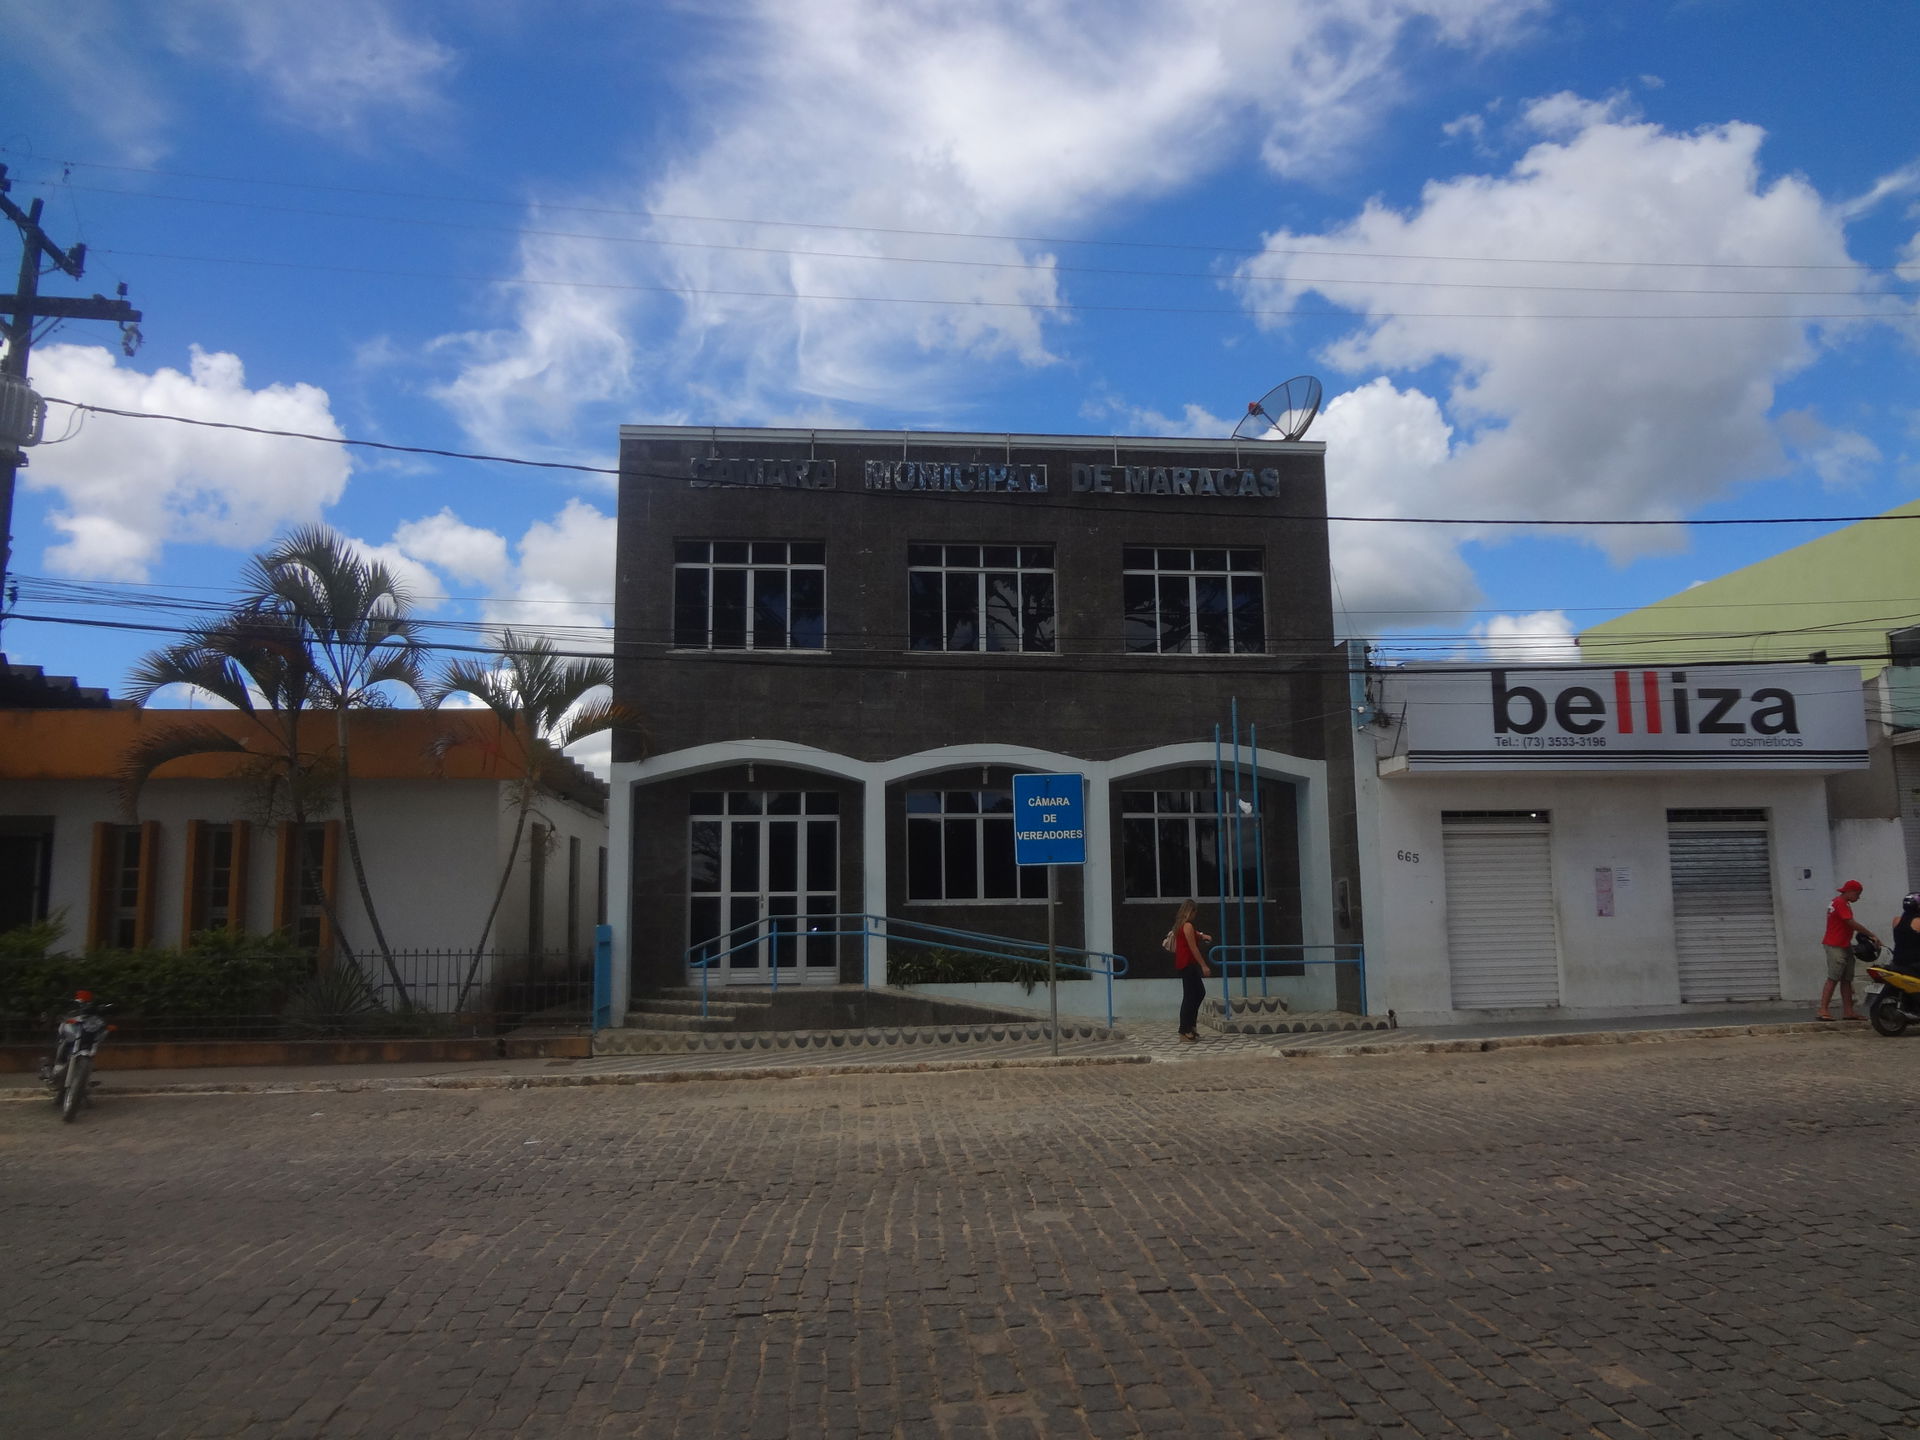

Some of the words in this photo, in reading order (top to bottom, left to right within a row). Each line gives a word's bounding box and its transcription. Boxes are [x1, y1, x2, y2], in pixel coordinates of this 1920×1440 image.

[865, 460, 1047, 492] MUNICIPAL
[1072, 463, 1113, 493] DE
[1491, 670, 1800, 735] belliza
[1494, 736, 1519, 747] Tel.:
[1523, 736, 1545, 749] (73)
[1548, 736, 1607, 747] 3533-3196
[1028, 796, 1070, 807] CÂMARA
[1043, 814, 1057, 823] DE
[1017, 830, 1083, 840] VEREADORES
[1397, 850, 1420, 864] 665
